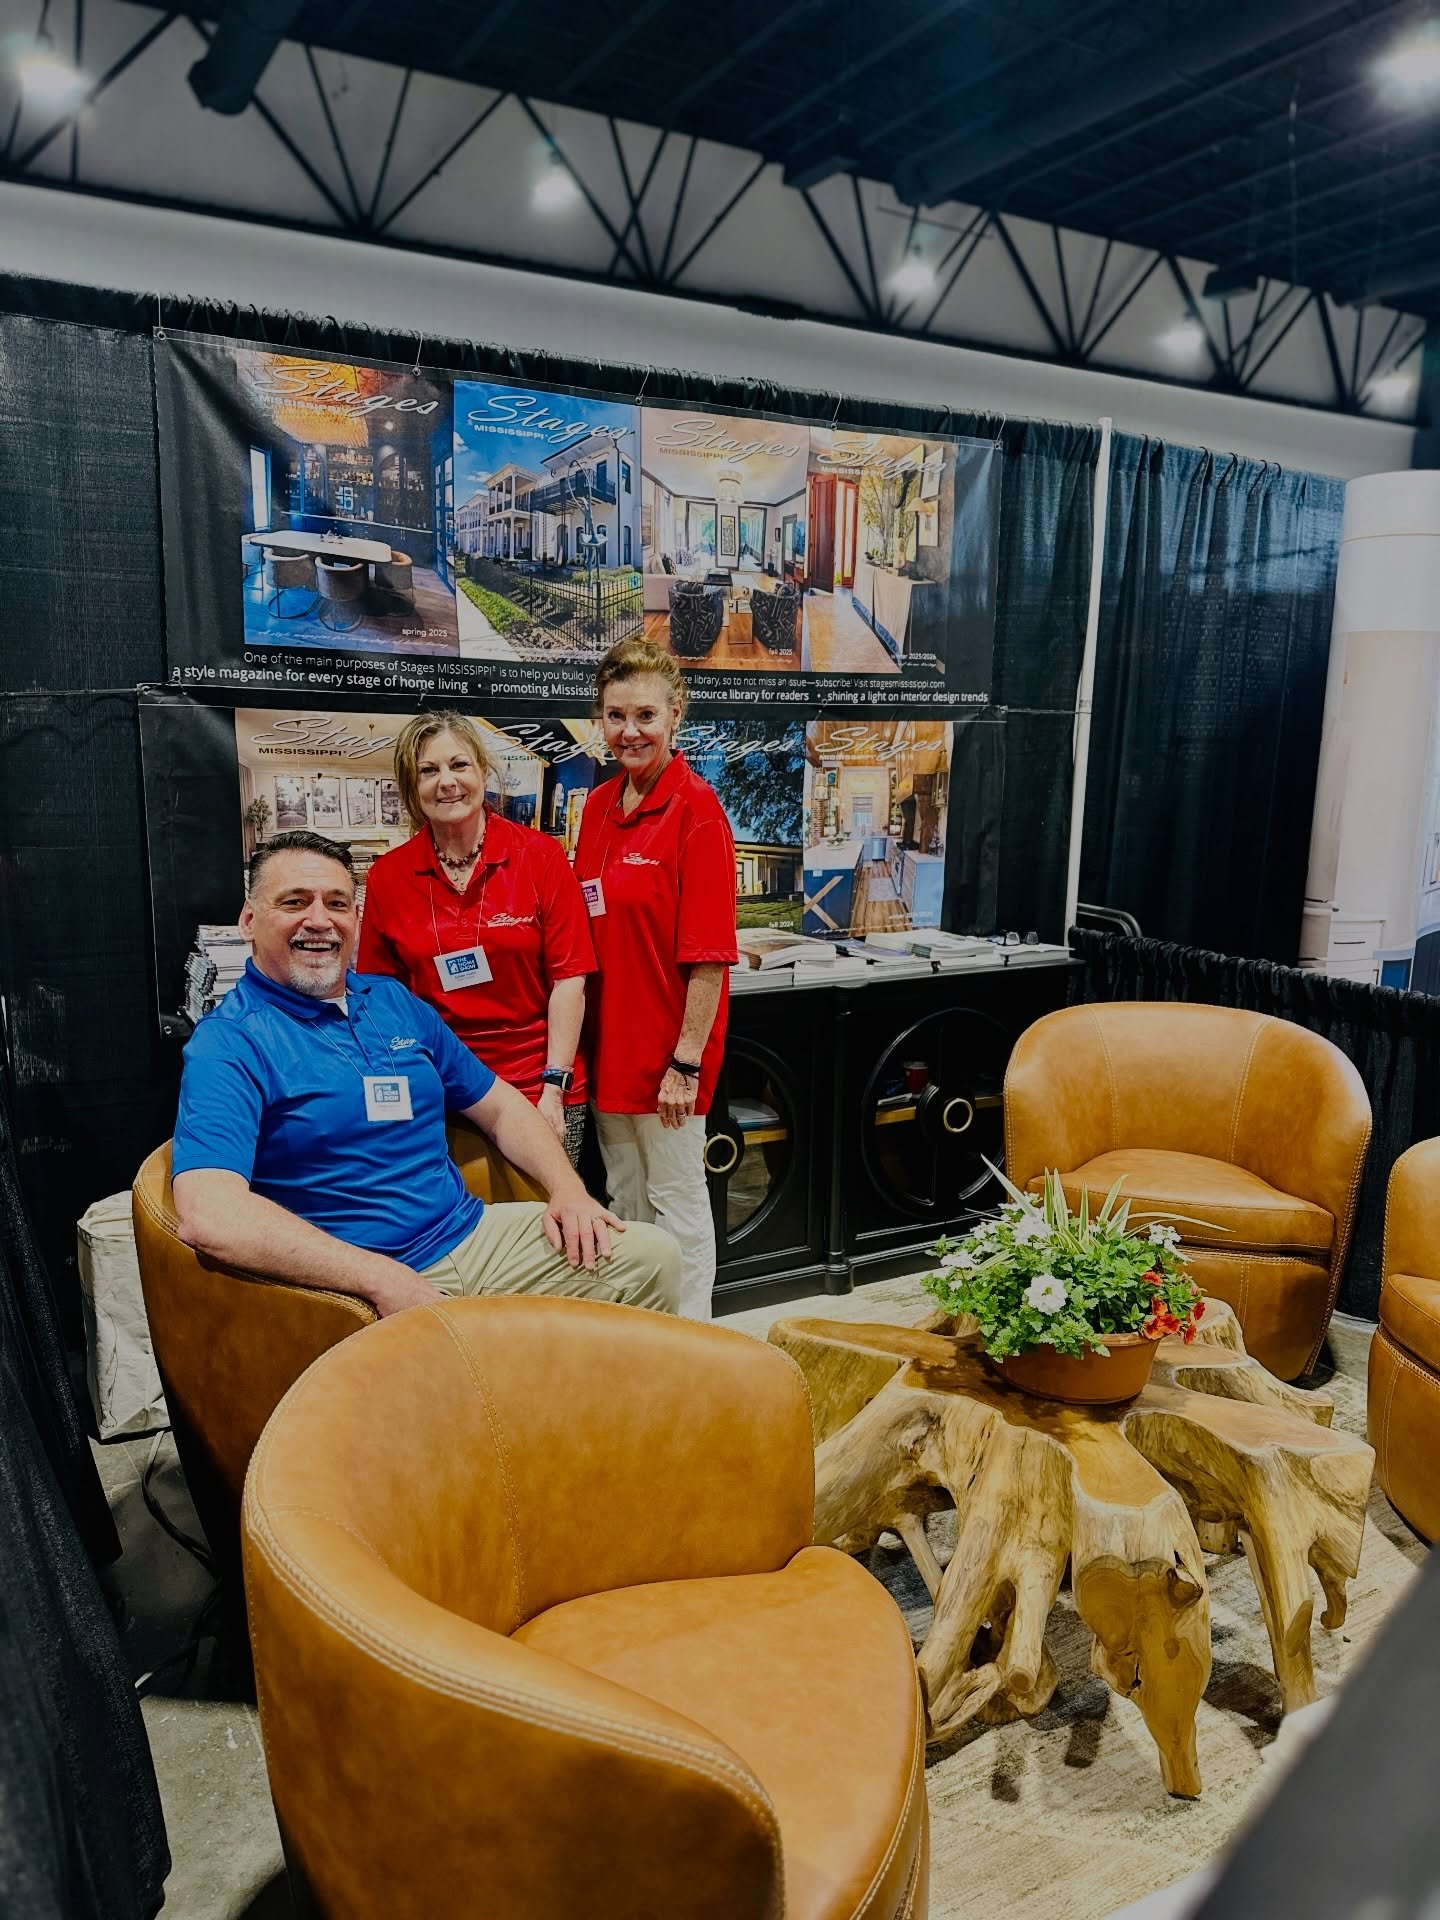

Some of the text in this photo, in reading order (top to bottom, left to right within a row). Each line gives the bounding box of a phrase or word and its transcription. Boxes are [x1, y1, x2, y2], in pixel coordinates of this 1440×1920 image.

[252, 366, 439, 418] Stages
[467, 395, 629, 444] Stages
[655, 418, 800, 463] Stages
[817, 441, 947, 479] Stages
[402, 628, 447, 637] spring 2025
[173, 665, 988, 704] a style magazine for every stage of home living promoting Mississip resource library for readers shining a light on interior design trends
[244, 652, 268, 663] One
[271, 653, 282, 663] of
[285, 653, 302, 665] the
[306, 656, 332, 666] main
[336, 659, 385, 670] purposes
[388, 660, 399, 671] of
[401, 661, 434, 675] Stages
[500, 667, 507, 677] is
[509, 669, 518, 678] to
[520, 668, 540, 680] help
[543, 671, 559, 681] you
[562, 669, 583, 680] build
[586, 673, 596, 683] yo
[723, 677, 731, 685] so
[734, 677, 741, 685] to
[744, 677, 756, 686] not
[759, 677, 776, 686] miss
[778, 678, 786, 686] an
[854, 679, 868, 688] Visit
[870, 680, 945, 690] stagesmississippi.com
[250, 717, 399, 759] Stag
[484, 723, 606, 763] Stag
[673, 726, 795, 762] Stages
[815, 727, 943, 761] Stages
